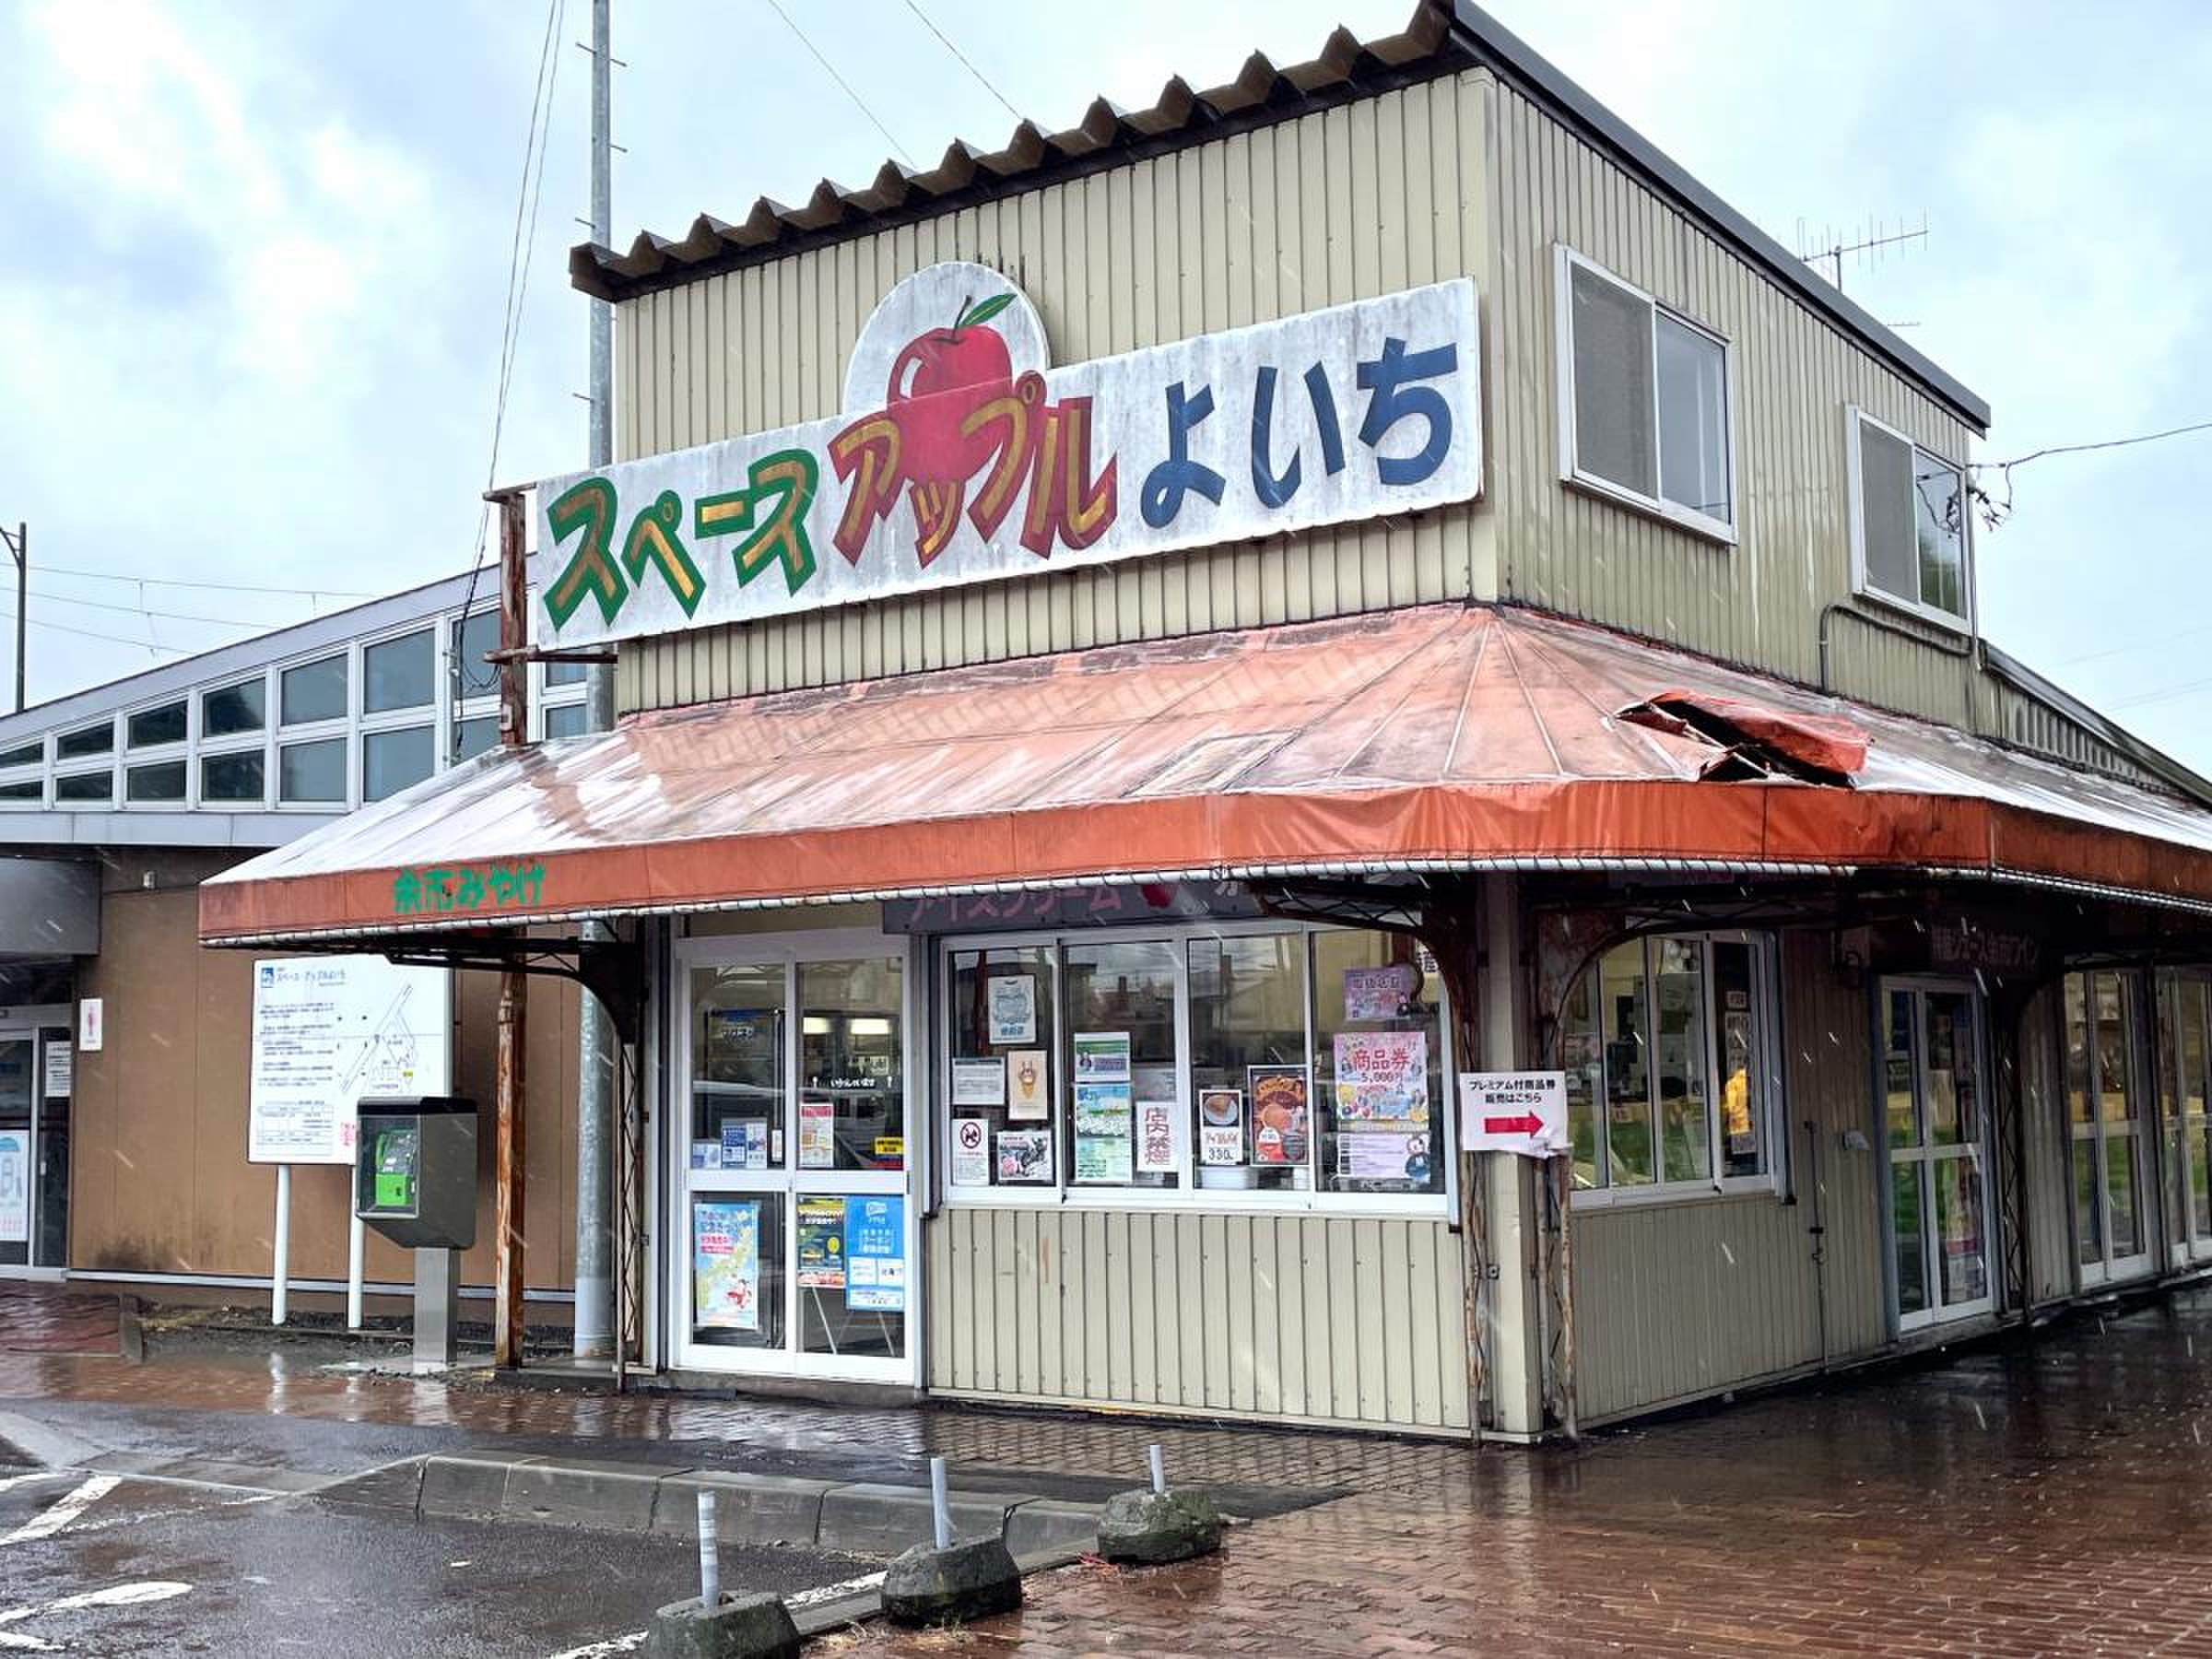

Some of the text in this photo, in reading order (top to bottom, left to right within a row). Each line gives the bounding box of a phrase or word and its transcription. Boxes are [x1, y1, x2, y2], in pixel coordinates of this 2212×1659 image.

[1356, 1048, 1409, 1071] 商品券
[1469, 1078, 1556, 1090] プレミアム付商品券
[1146, 1107, 1171, 1165] 店内禁煙
